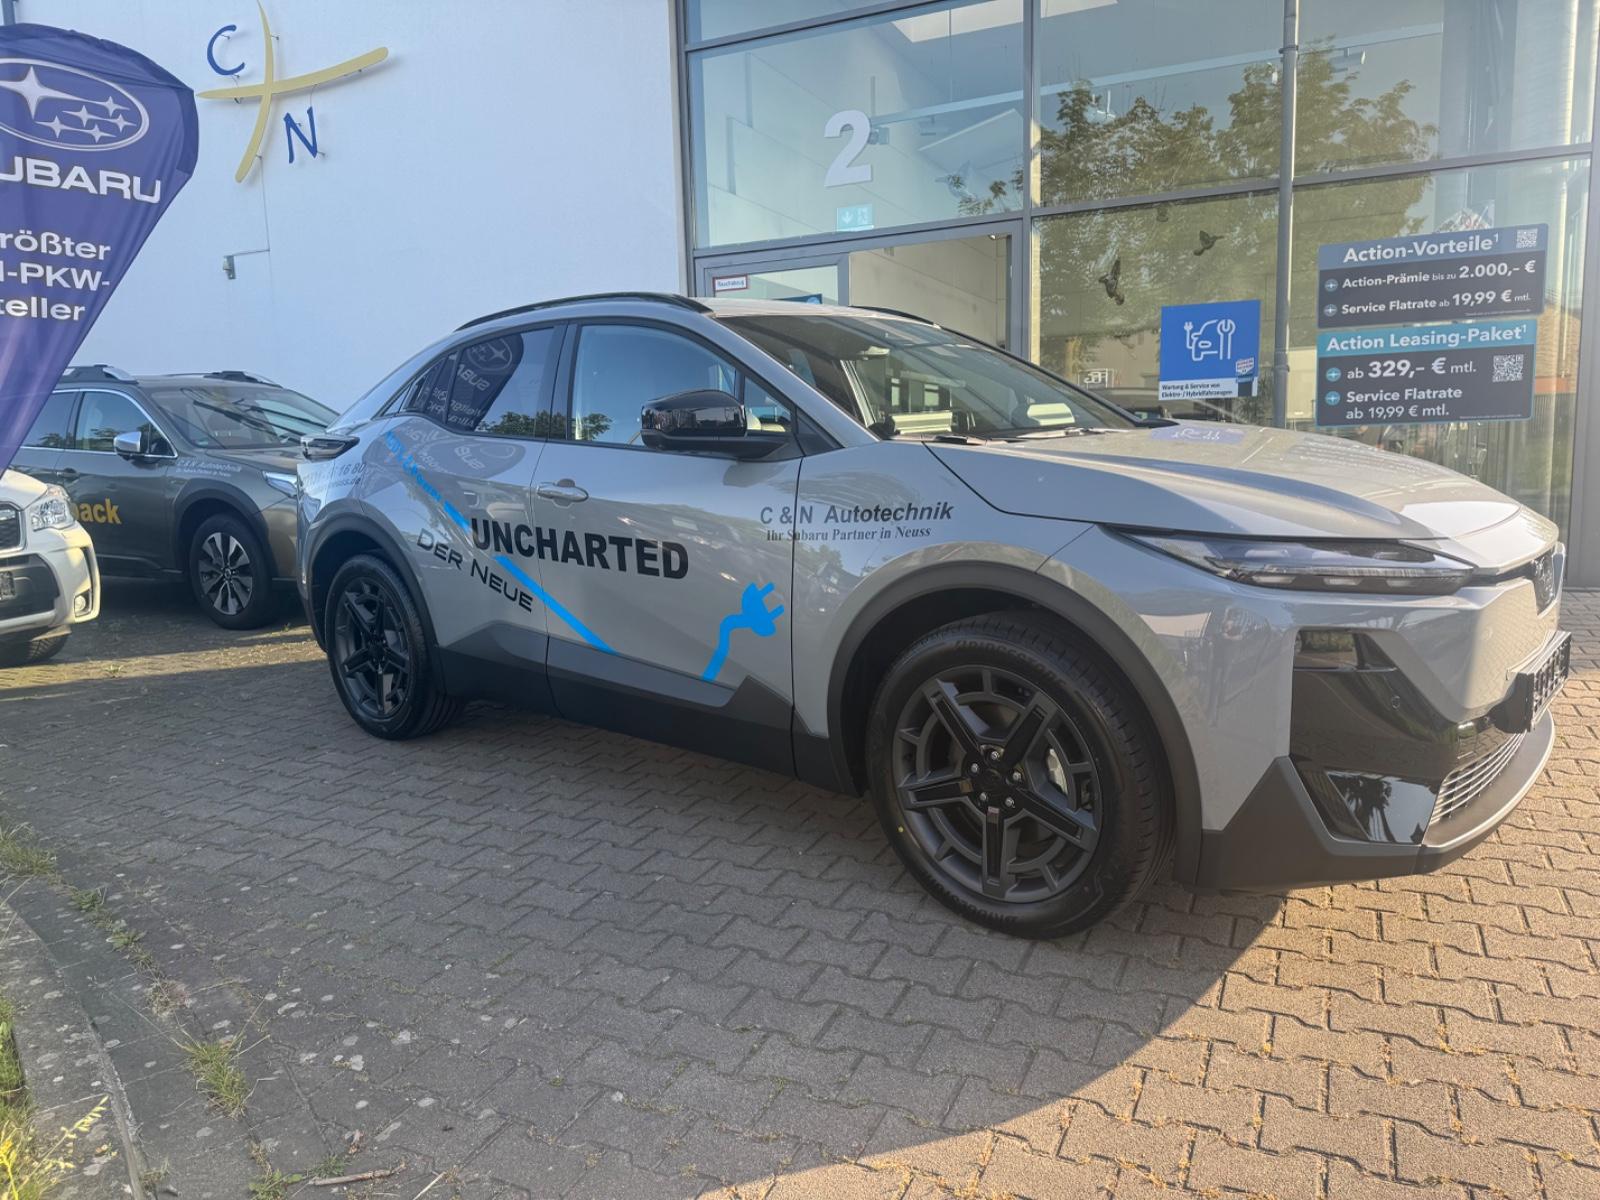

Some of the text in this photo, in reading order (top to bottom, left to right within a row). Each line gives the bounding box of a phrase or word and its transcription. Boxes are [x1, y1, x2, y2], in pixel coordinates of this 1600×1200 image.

[207, 24, 246, 76] C
[283, 106, 319, 164] N
[823, 109, 873, 187] 2
[0, 156, 162, 204] UBARU
[0, 229, 111, 260] rößter
[1342, 271, 1430, 289] Action-Prämie
[1432, 273, 1445, 281] bis
[1524, 259, 1536, 273] €
[1341, 302, 1386, 315] Service
[1389, 298, 1437, 311] Flatrate
[1439, 299, 1450, 307] ab
[1452, 290, 1497, 307] 19,99
[1501, 289, 1512, 303] €
[1326, 335, 1384, 352] Action
[1347, 366, 1364, 380] ab
[1431, 356, 1447, 374] €
[1450, 360, 1477, 374] mtl.
[1346, 387, 1463, 403] Service Flatrate
[1346, 407, 1364, 419] ab
[1368, 405, 1405, 420] 19,99
[1408, 404, 1419, 417] €
[1422, 403, 1450, 417] mtl.
[760, 501, 954, 525] C & N Autotechnik
[766, 525, 931, 541] Ihr Subaru Partner in Neuss
[471, 517, 689, 580] UNCHARTED
[416, 528, 534, 613] DER NEUE
